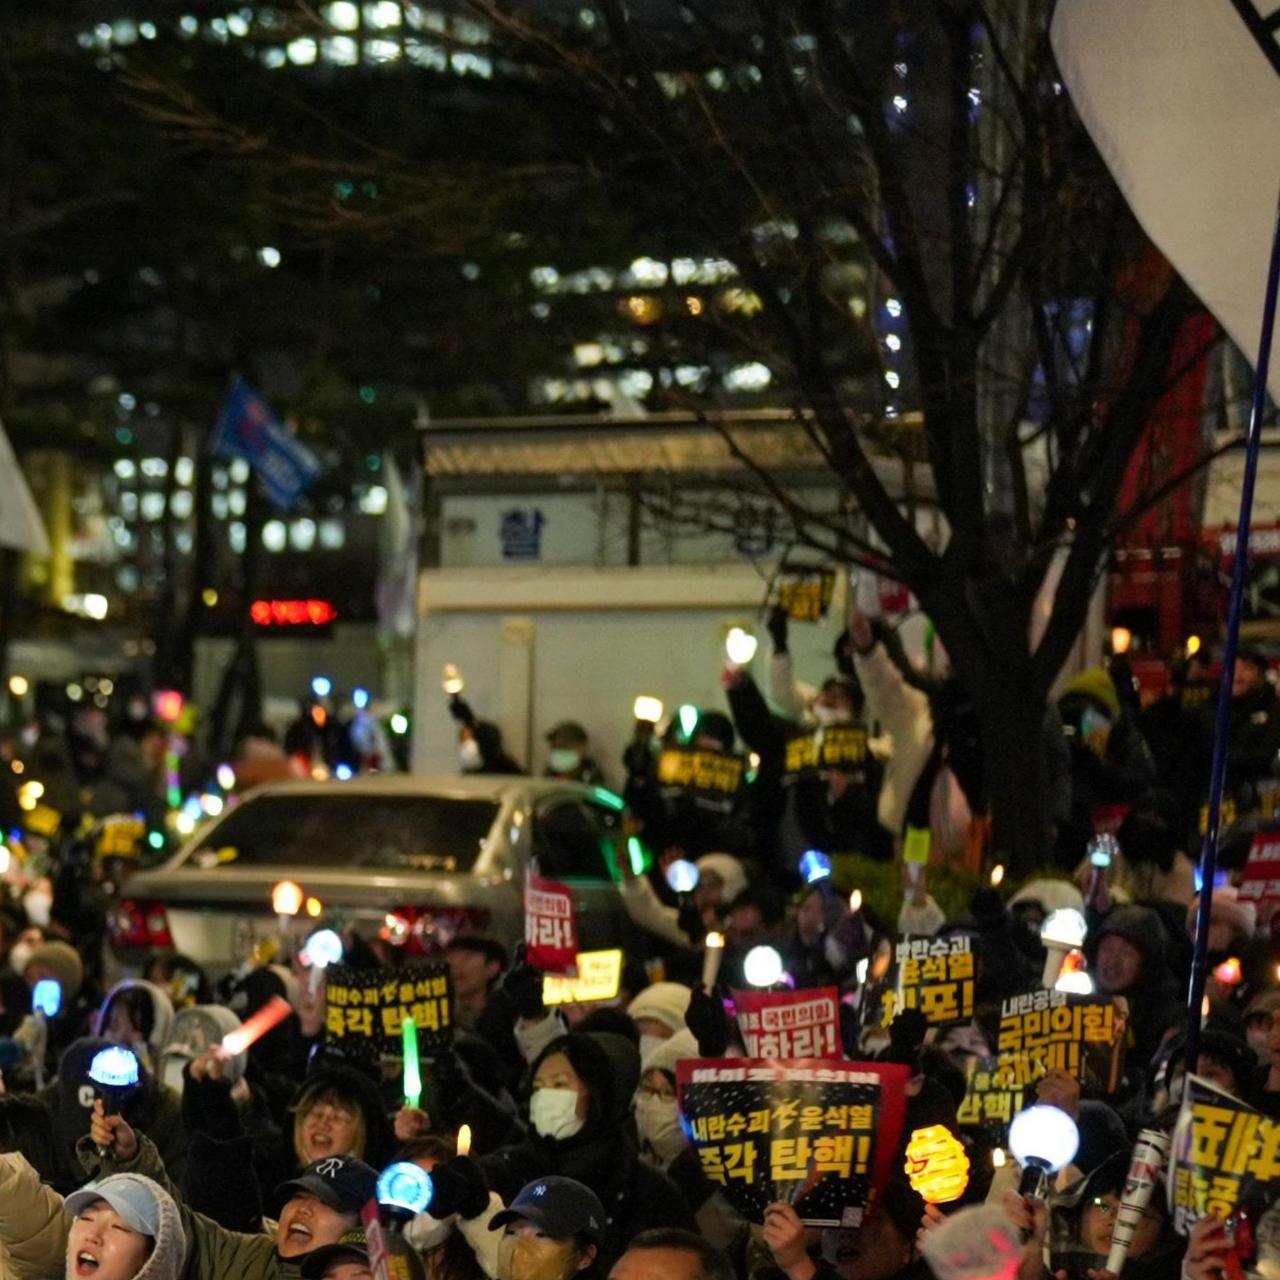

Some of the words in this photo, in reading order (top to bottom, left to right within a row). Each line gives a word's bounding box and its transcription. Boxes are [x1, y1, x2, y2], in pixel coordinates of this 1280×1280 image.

[896, 936, 971, 962] 반란수괴
[901, 952, 974, 987] 윤석열
[998, 1003, 1115, 1051] 국민의힘
[691, 1109, 770, 1142] 내란수괴
[799, 1104, 873, 1130] 윤석열
[698, 1140, 757, 1186] 즉각
[770, 1135, 871, 1180] 탄핵!
